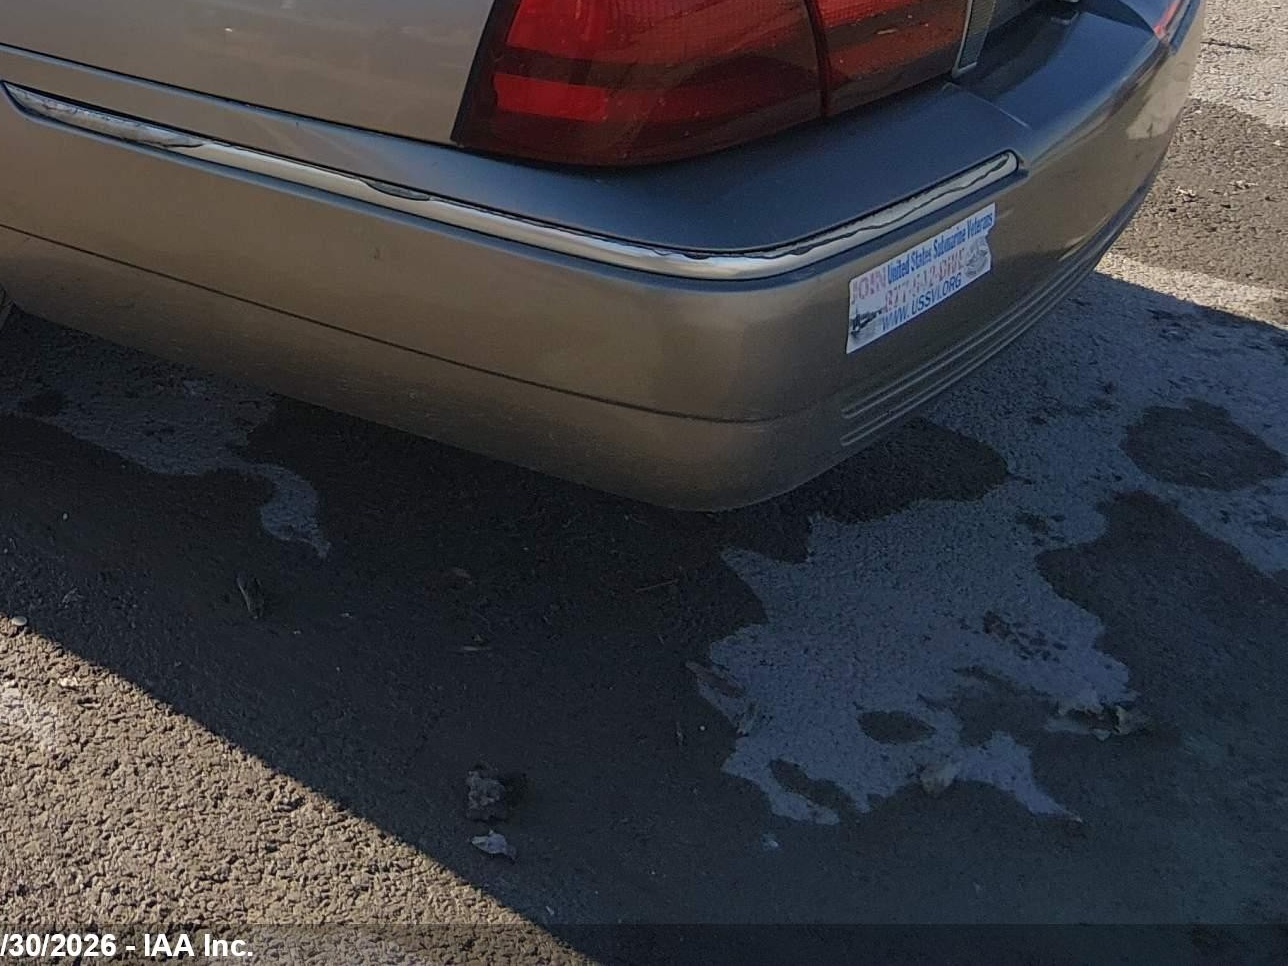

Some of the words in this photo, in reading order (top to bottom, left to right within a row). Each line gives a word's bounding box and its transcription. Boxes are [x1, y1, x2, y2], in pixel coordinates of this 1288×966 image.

[851, 267, 886, 304] JOIN
[887, 254, 910, 285] United
[911, 248, 932, 272] States
[934, 228, 966, 259] Submarine
[967, 213, 993, 239] Veterans
